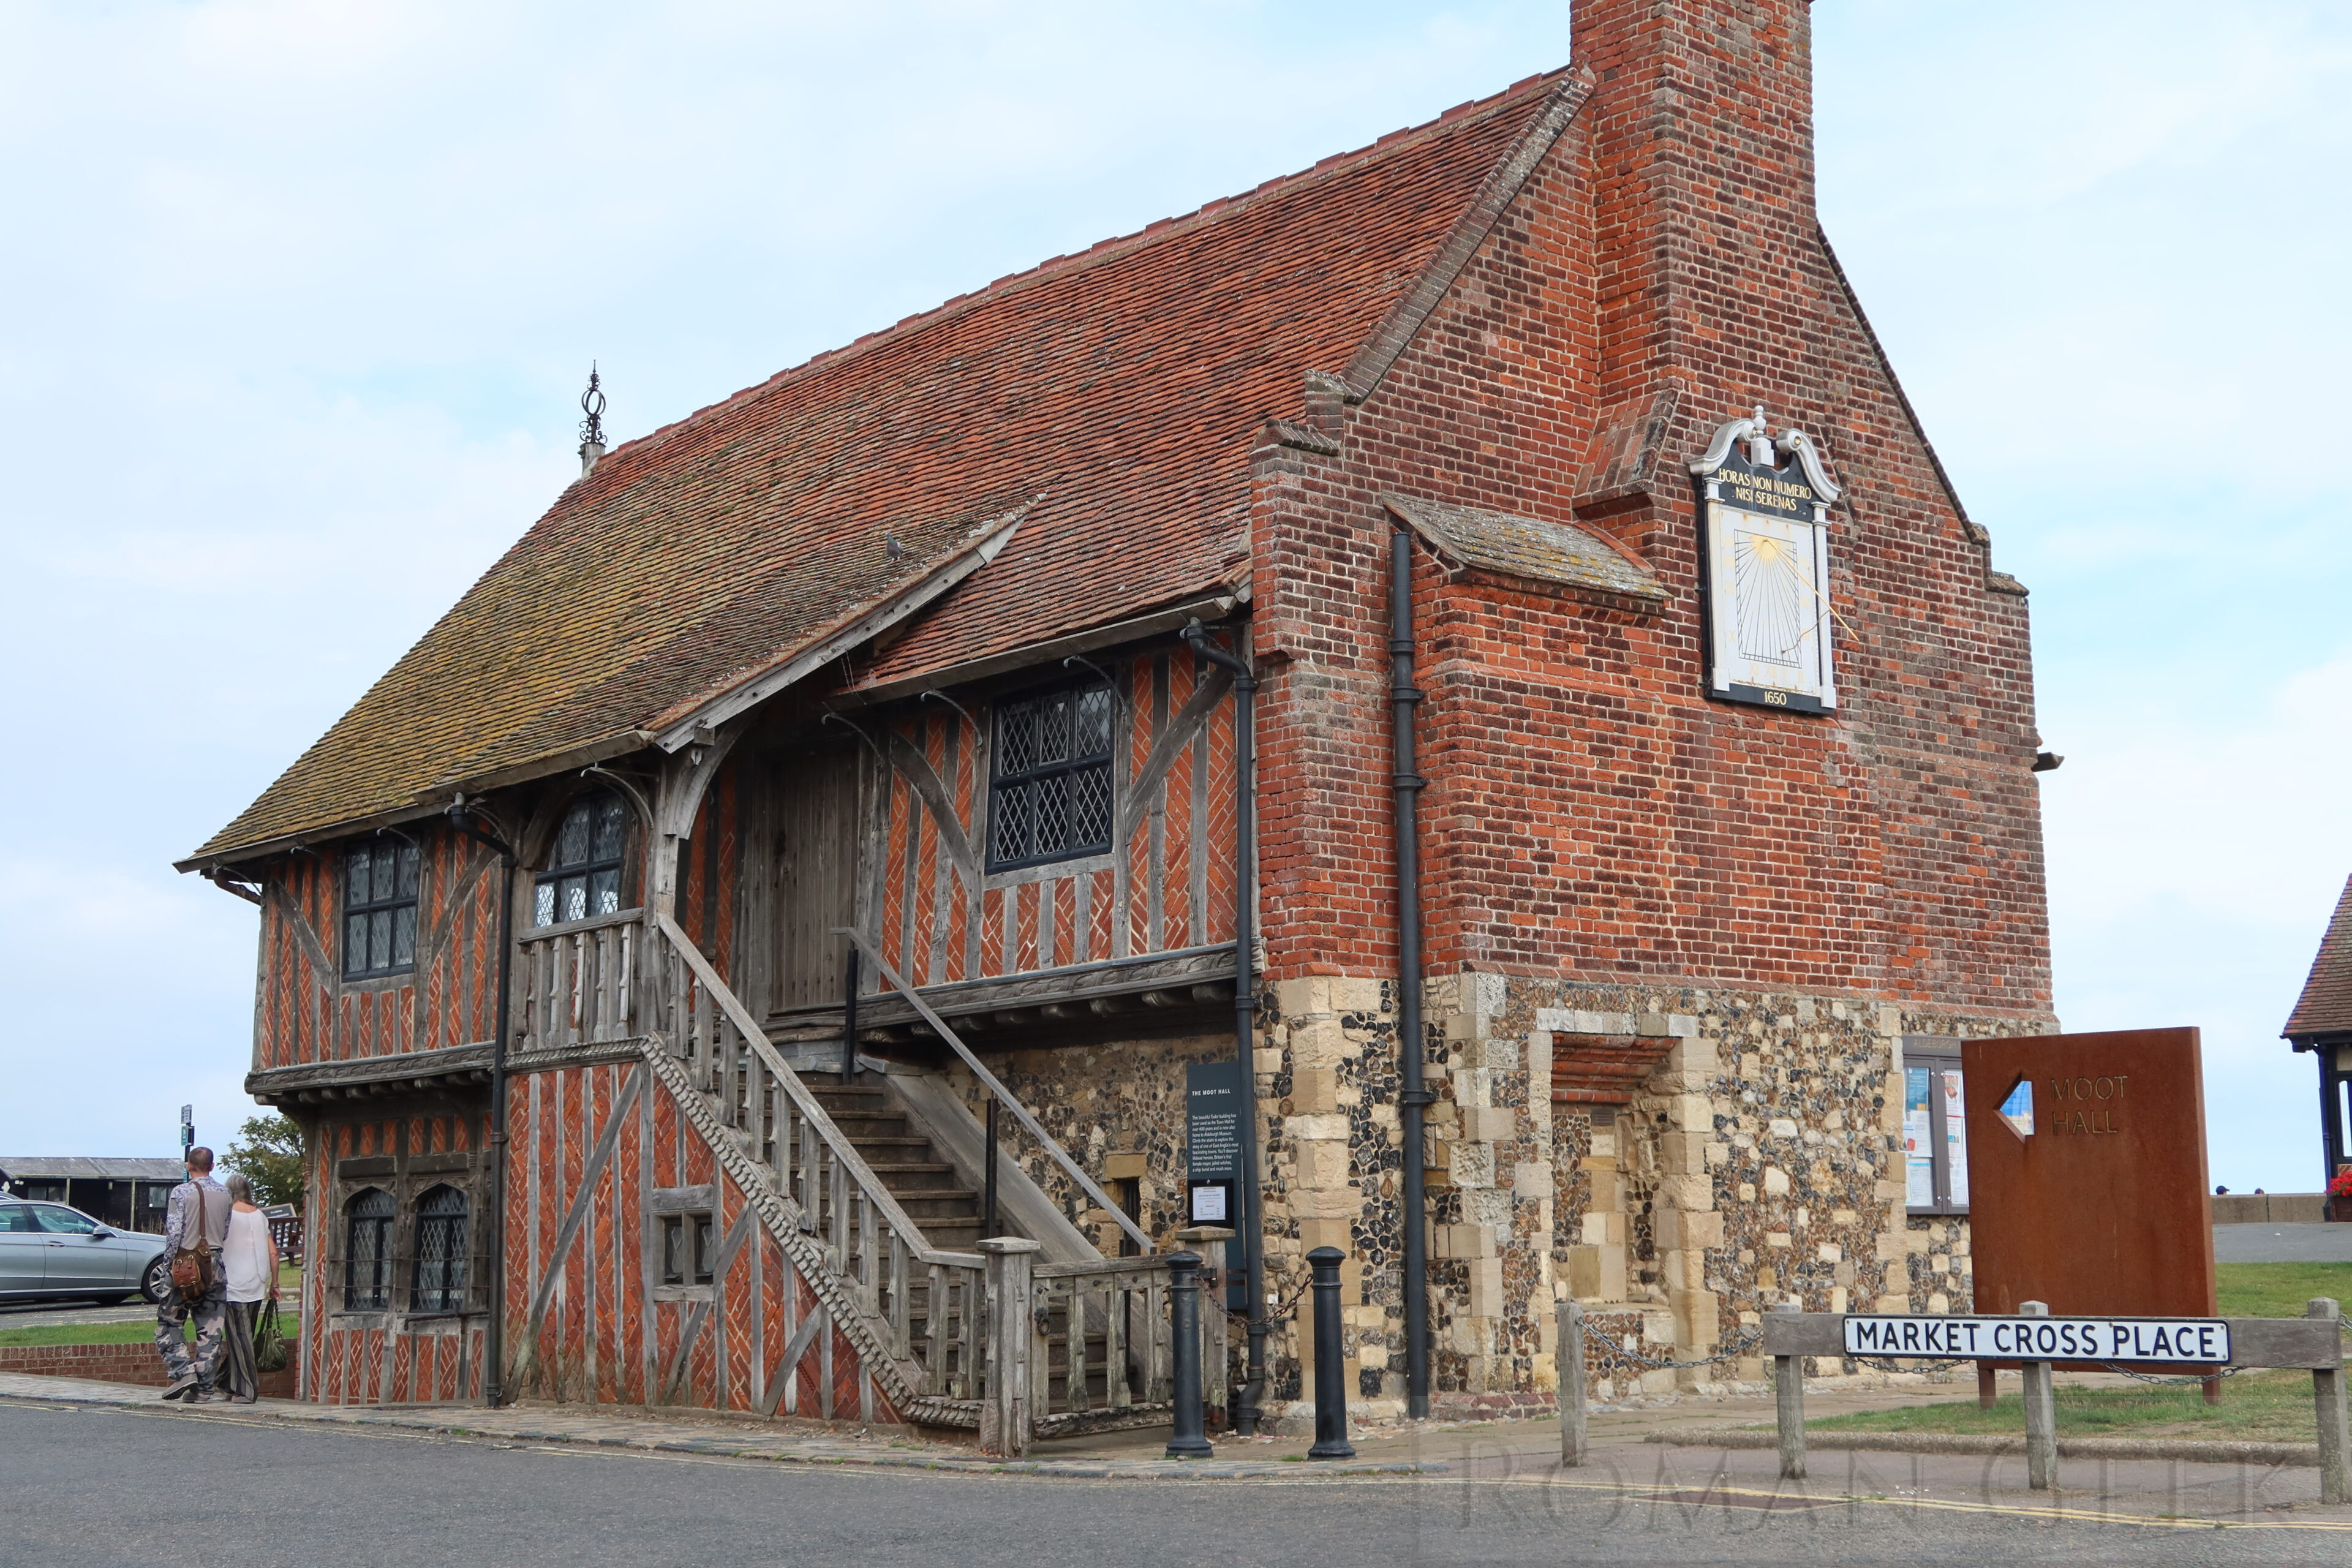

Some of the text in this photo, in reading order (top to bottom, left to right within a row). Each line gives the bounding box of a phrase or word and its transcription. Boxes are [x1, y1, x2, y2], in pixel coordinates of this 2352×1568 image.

[1719, 468, 1812, 500] HORAS NON NUMERO
[1736, 487, 1797, 511] NISI SERENAS
[1765, 691, 1787, 705] 1650
[1913, 1038, 1956, 1049] ALDEBURGH
[2051, 1076, 2128, 1102] MOOT
[2052, 1109, 2117, 1135] HALL
[1856, 1322, 2217, 1357] MARKET CROSS PLACE
